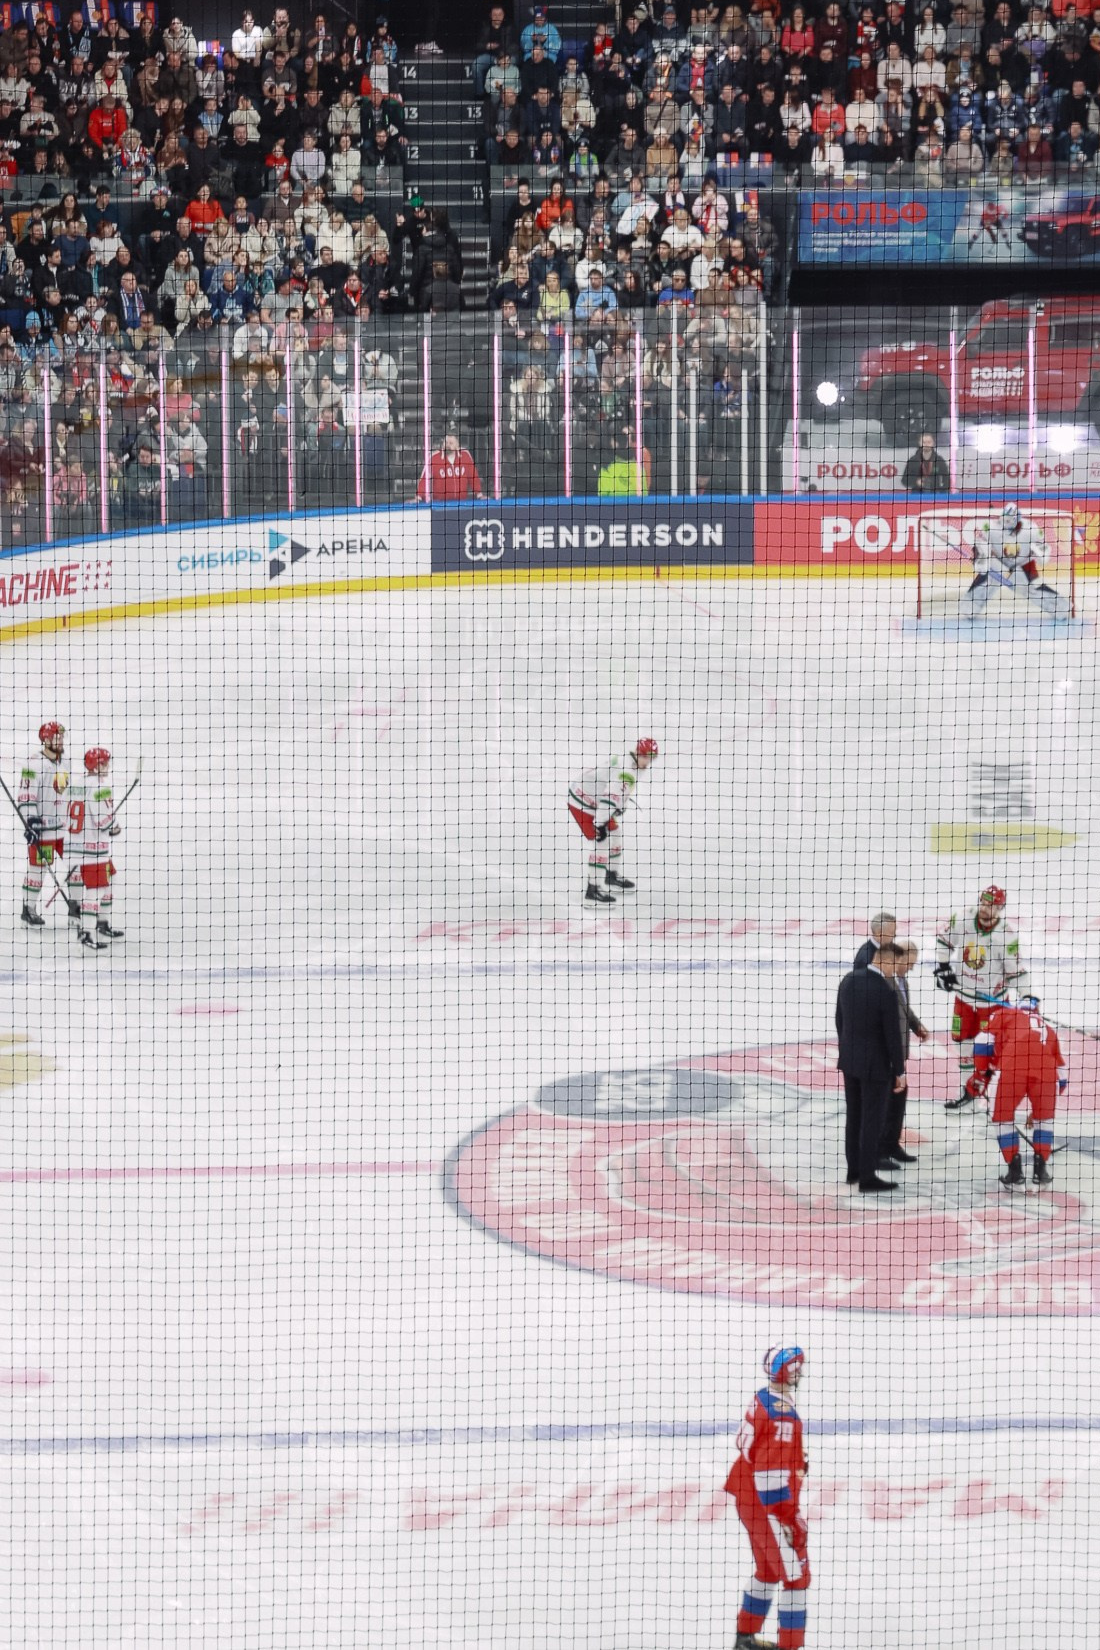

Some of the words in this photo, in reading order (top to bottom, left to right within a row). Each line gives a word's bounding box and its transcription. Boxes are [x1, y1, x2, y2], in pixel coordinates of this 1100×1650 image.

[401, 65, 417, 79] 14
[404, 107, 419, 119] 13
[466, 106, 482, 119] 13
[407, 145, 419, 159] 12
[810, 201, 928, 226] РОЛЬФ
[970, 366, 1026, 380] РОЛЬФ
[817, 463, 899, 480] РОЛЬФ
[512, 523, 723, 549] HENDERSON
[177, 549, 262, 572] СИБИРЬ
[316, 538, 389, 558] АРЕНА
[67, 800, 86, 835] 9
